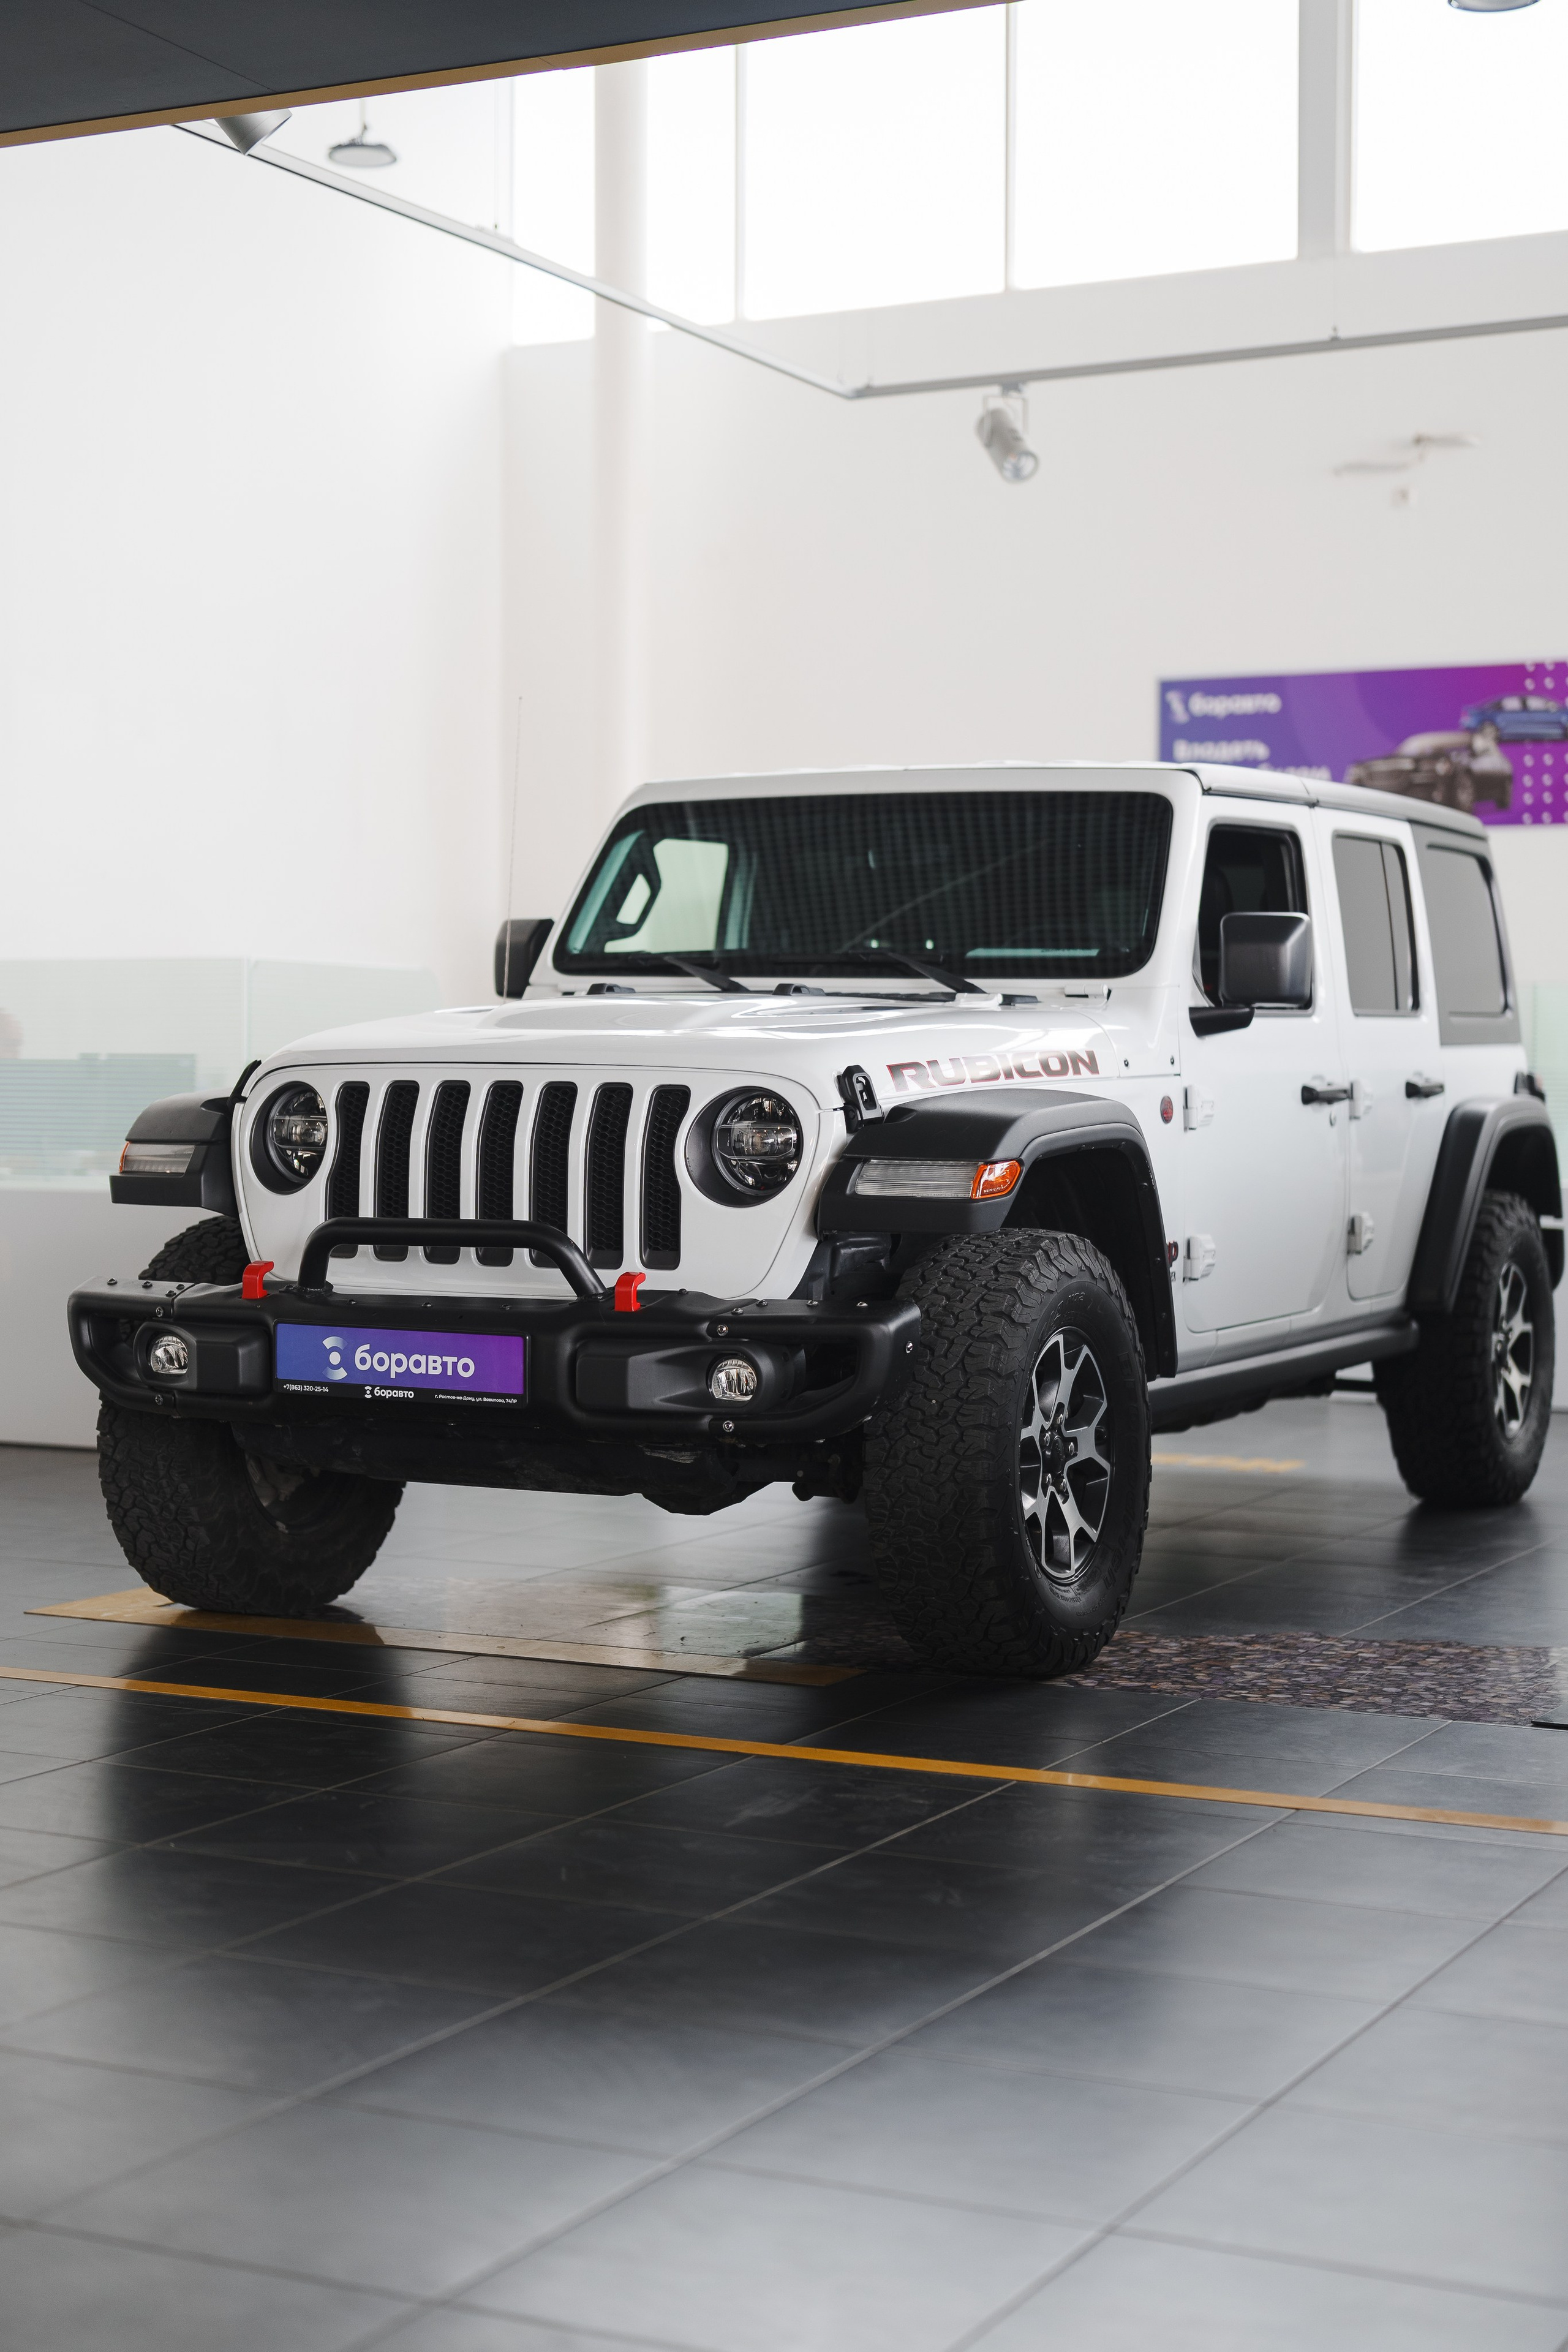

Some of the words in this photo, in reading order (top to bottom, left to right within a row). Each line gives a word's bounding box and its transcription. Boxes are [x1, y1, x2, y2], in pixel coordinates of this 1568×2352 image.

[886, 1050, 1099, 1092] RUBICON
[355, 1343, 475, 1378] боравто
[374, 1387, 414, 1398] боравто
